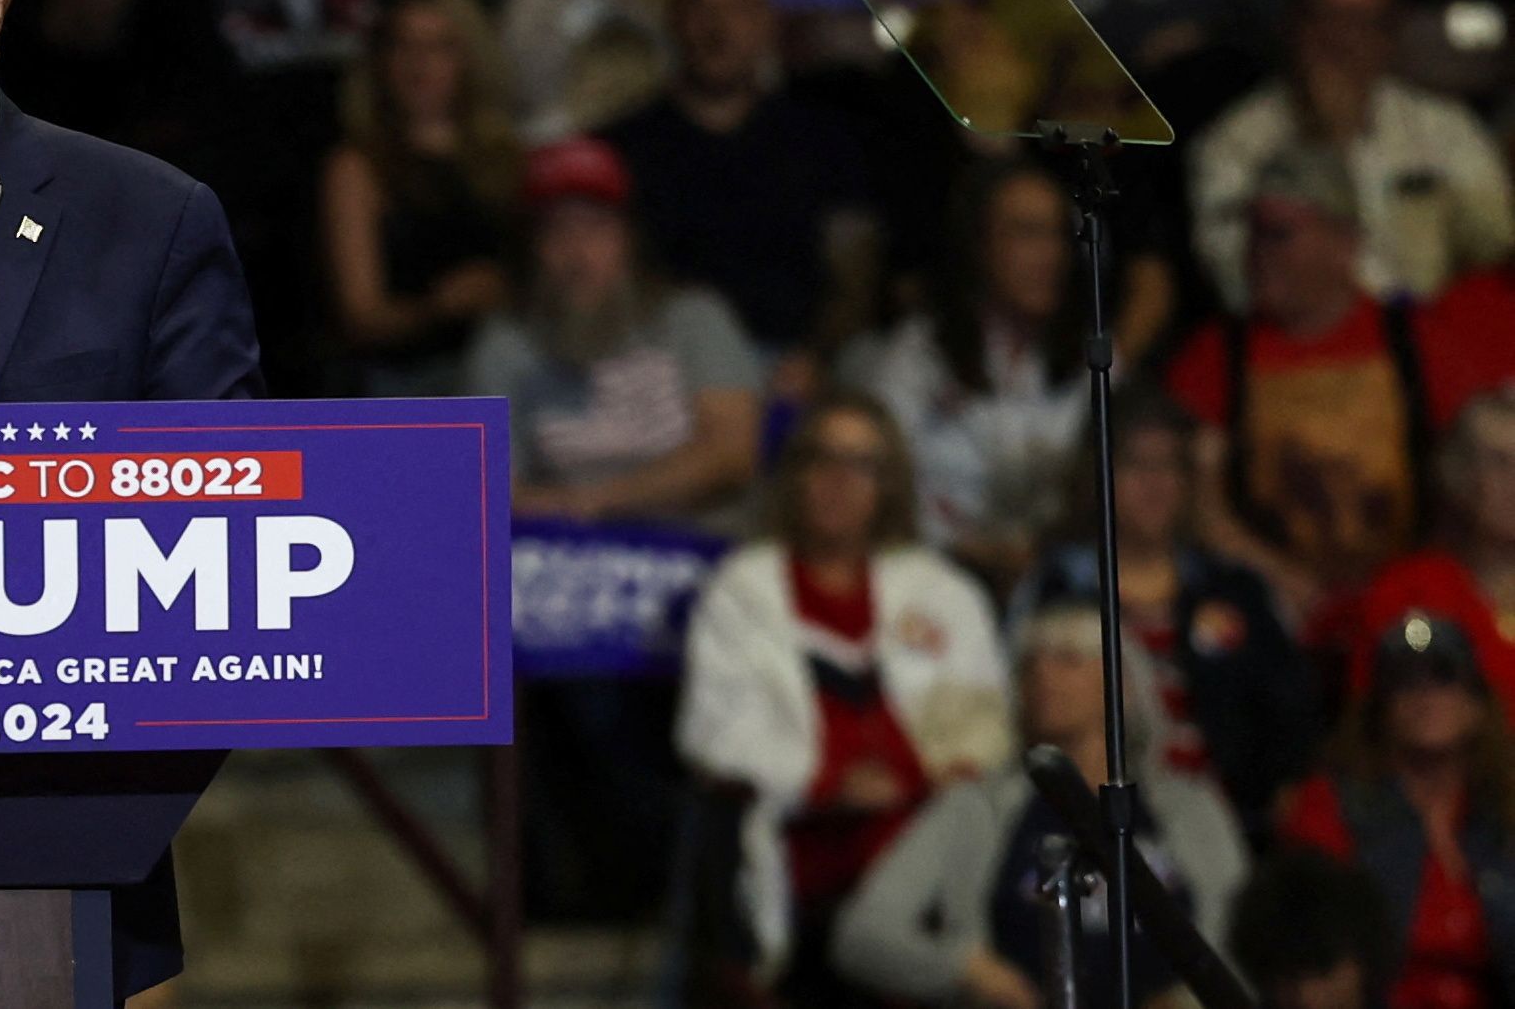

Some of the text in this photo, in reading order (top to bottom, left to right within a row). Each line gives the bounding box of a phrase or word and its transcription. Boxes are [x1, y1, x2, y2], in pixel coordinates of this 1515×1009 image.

[28, 460, 95, 498] TO
[110, 457, 262, 497] 88022
[56, 656, 178, 684] GREAT
[192, 654, 324, 681] AGAIN!
